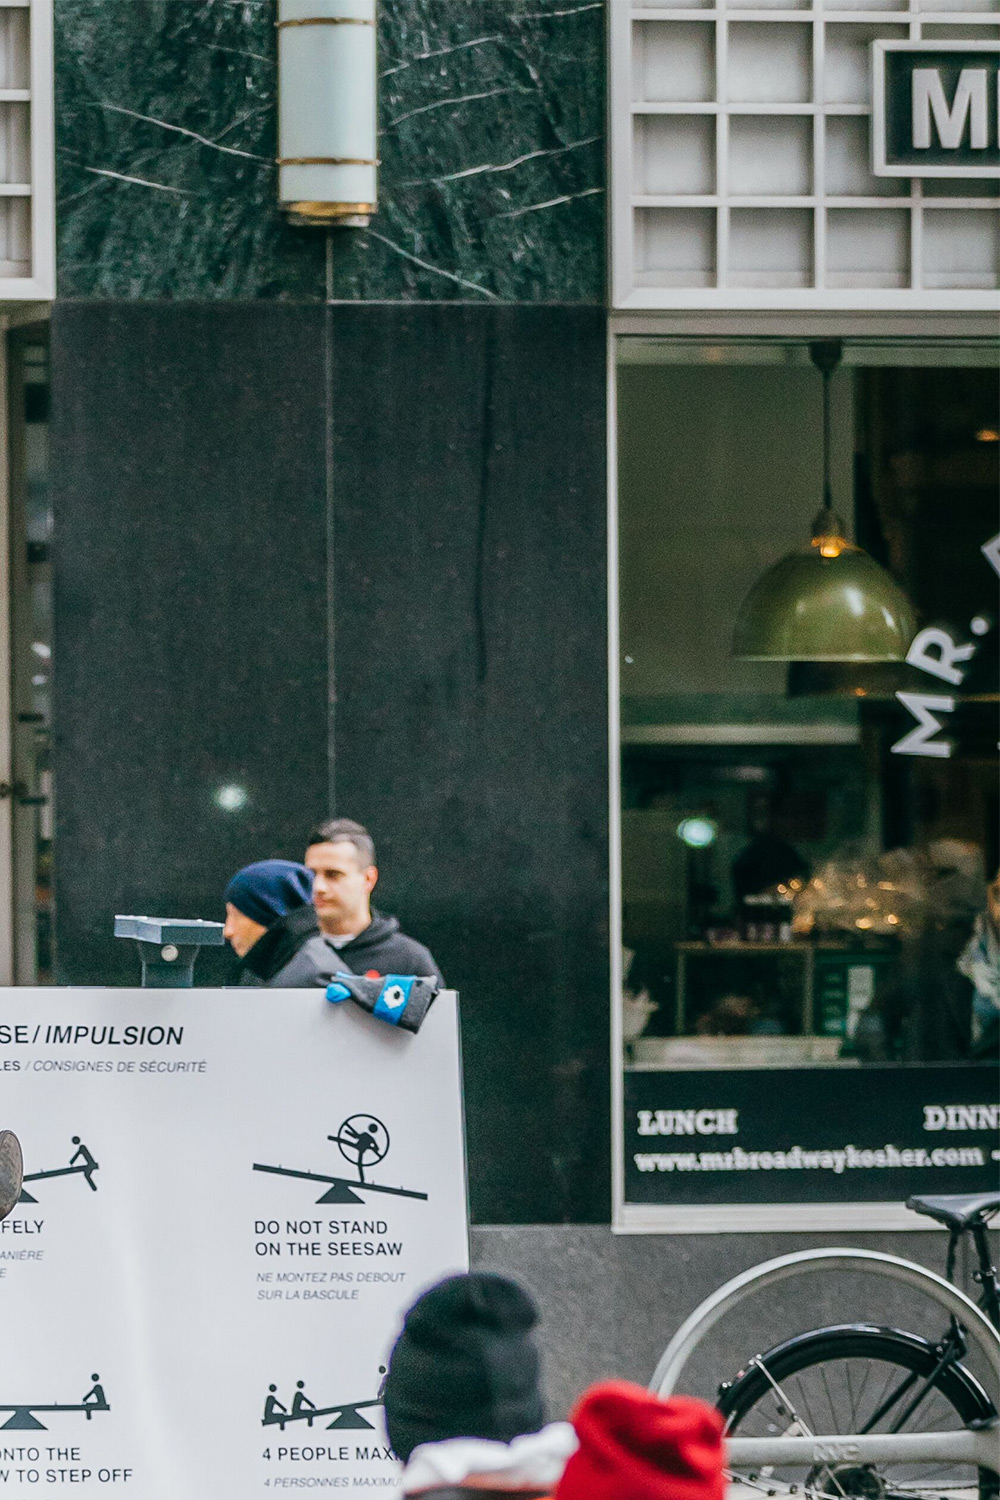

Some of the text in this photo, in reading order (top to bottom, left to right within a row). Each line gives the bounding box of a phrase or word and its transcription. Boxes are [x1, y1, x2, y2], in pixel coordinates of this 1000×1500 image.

[911, 68, 1000, 149] M
[890, 616, 990, 758] MR.
[116, 1061, 135, 1073] DE
[637, 1104, 1000, 1135] LUNCH DINN
[633, 1144, 986, 1174] www.mrbroadwaykosher.com
[254, 1220, 388, 1235] DO NOT STAND
[254, 1241, 403, 1256] ON THE SEESAW
[256, 1272, 406, 1283] NE MONTEZ PAS DEBOUT
[257, 1289, 360, 1300] SUR LA BASCULE
[45, 1448, 81, 1461] THE
[262, 1448, 271, 1461] 4
[278, 1447, 349, 1461] PEOPLE
[16, 1469, 40, 1484] TO
[45, 1469, 92, 1483] STEP
[97, 1469, 134, 1483] OFF
[264, 1479, 271, 1487] 4
[274, 1477, 349, 1488] PERSONNES
